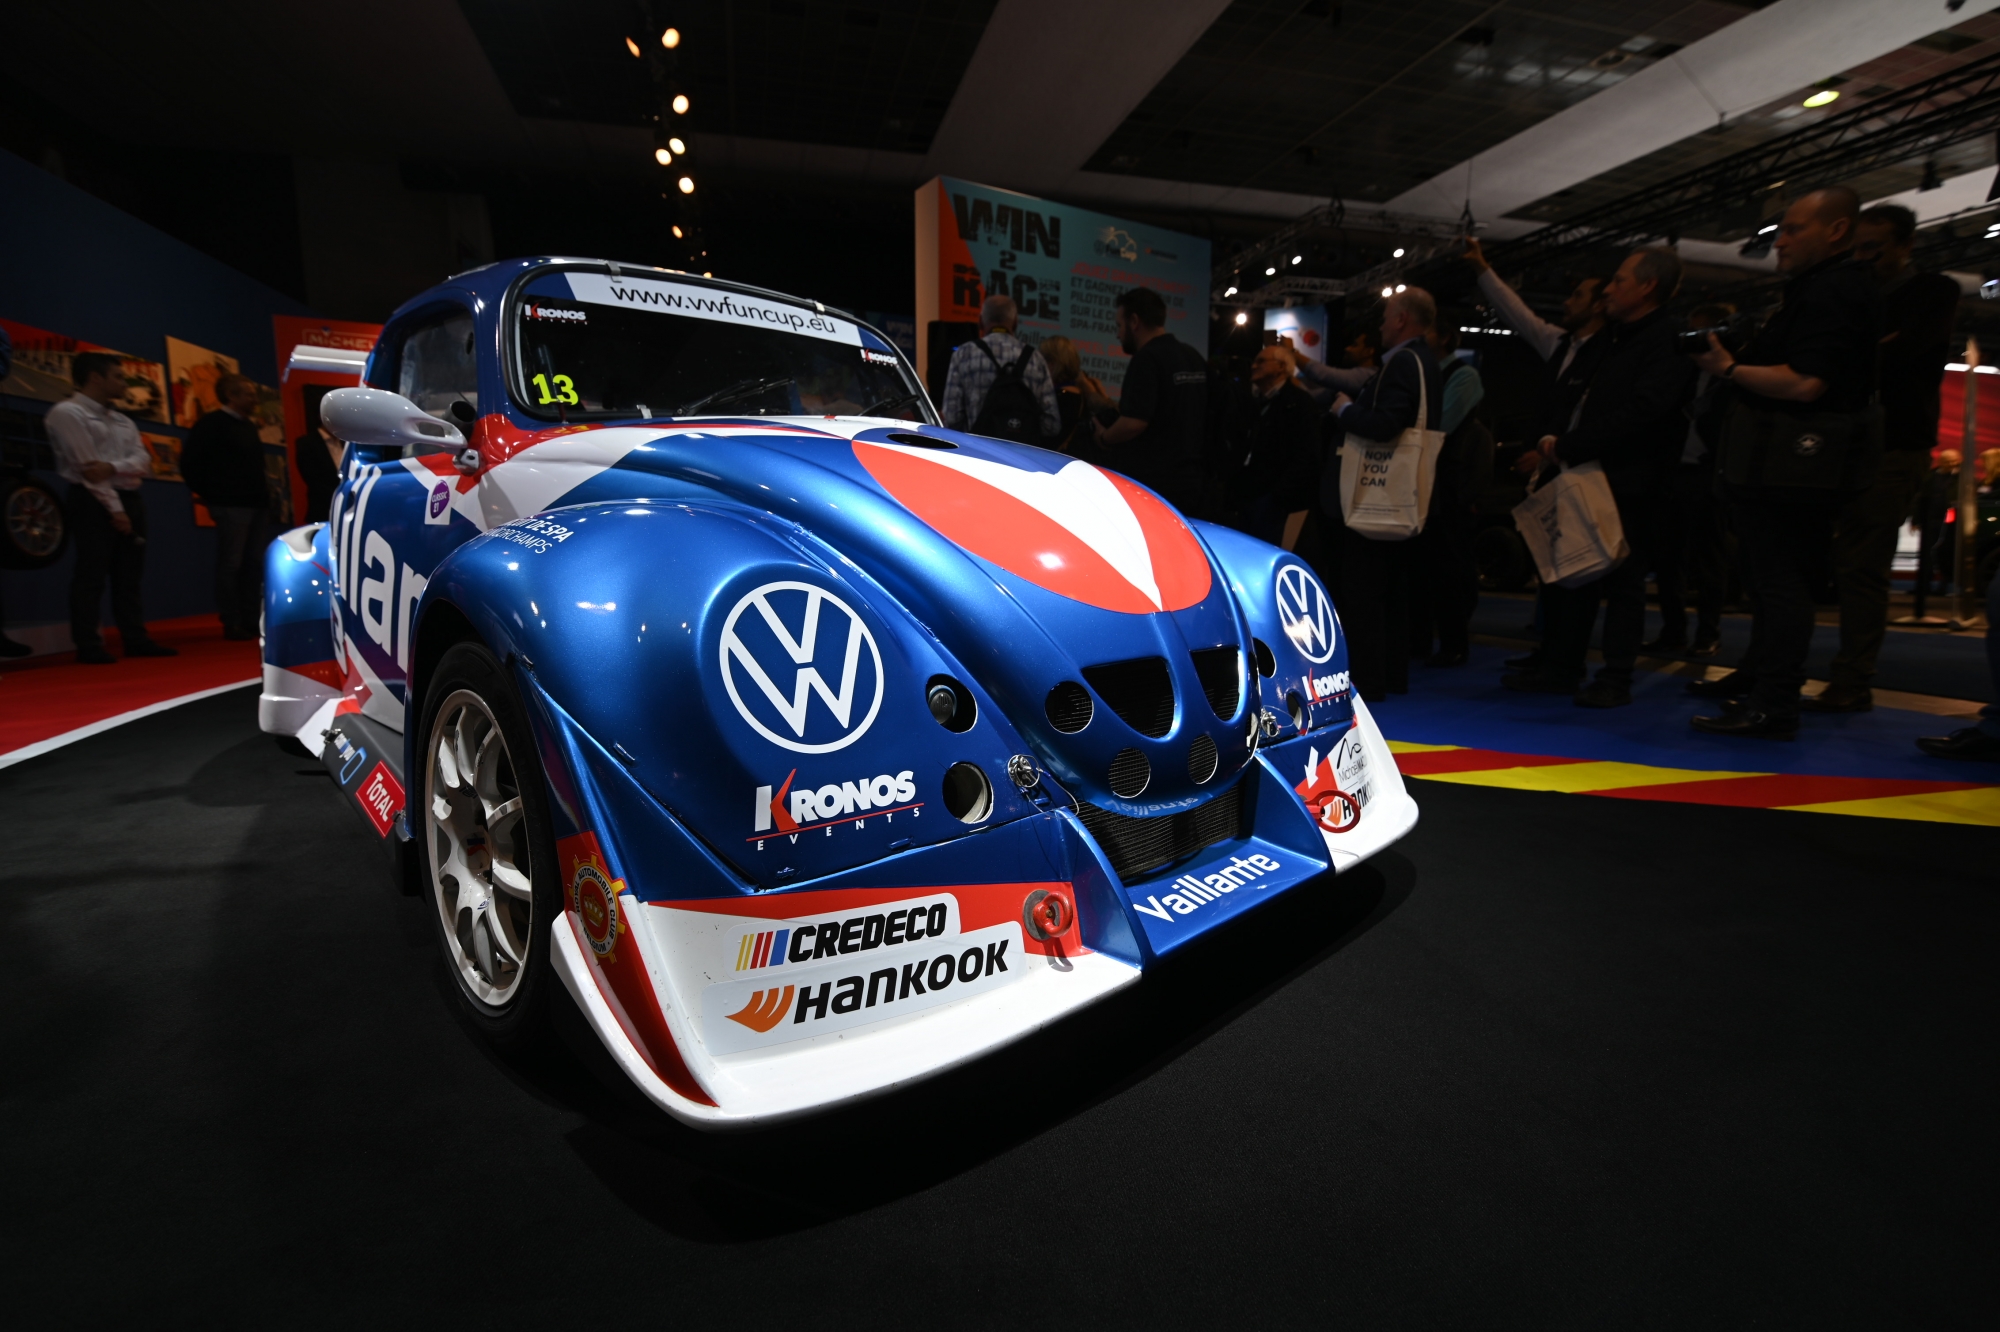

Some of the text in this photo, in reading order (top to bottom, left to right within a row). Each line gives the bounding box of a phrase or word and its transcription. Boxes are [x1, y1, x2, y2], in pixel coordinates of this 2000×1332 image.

[953, 193, 1060, 258] WIN
[1000, 251, 1016, 270] 2
[525, 303, 586, 320] KRONOS
[610, 286, 836, 333] www.vwfuncup.eu
[1070, 304, 1090, 316] SUR
[1092, 308, 1104, 319] LE
[1071, 291, 1111, 307] PILOTER
[532, 374, 578, 405] 13
[1363, 463, 1388, 474] YOU
[1365, 450, 1393, 461] NOW
[1361, 477, 1386, 487] CAN
[541, 522, 574, 543] SPA
[1302, 668, 1349, 701] KRONOS
[366, 772, 394, 822] TOTAL
[755, 768, 916, 832] KRONOS
[757, 808, 919, 851] EVENTS
[578, 867, 614, 905] AUTOMOBILE
[607, 909, 616, 940] CLUB
[1133, 853, 1280, 923] Vaillante
[788, 903, 948, 963] CREDECO
